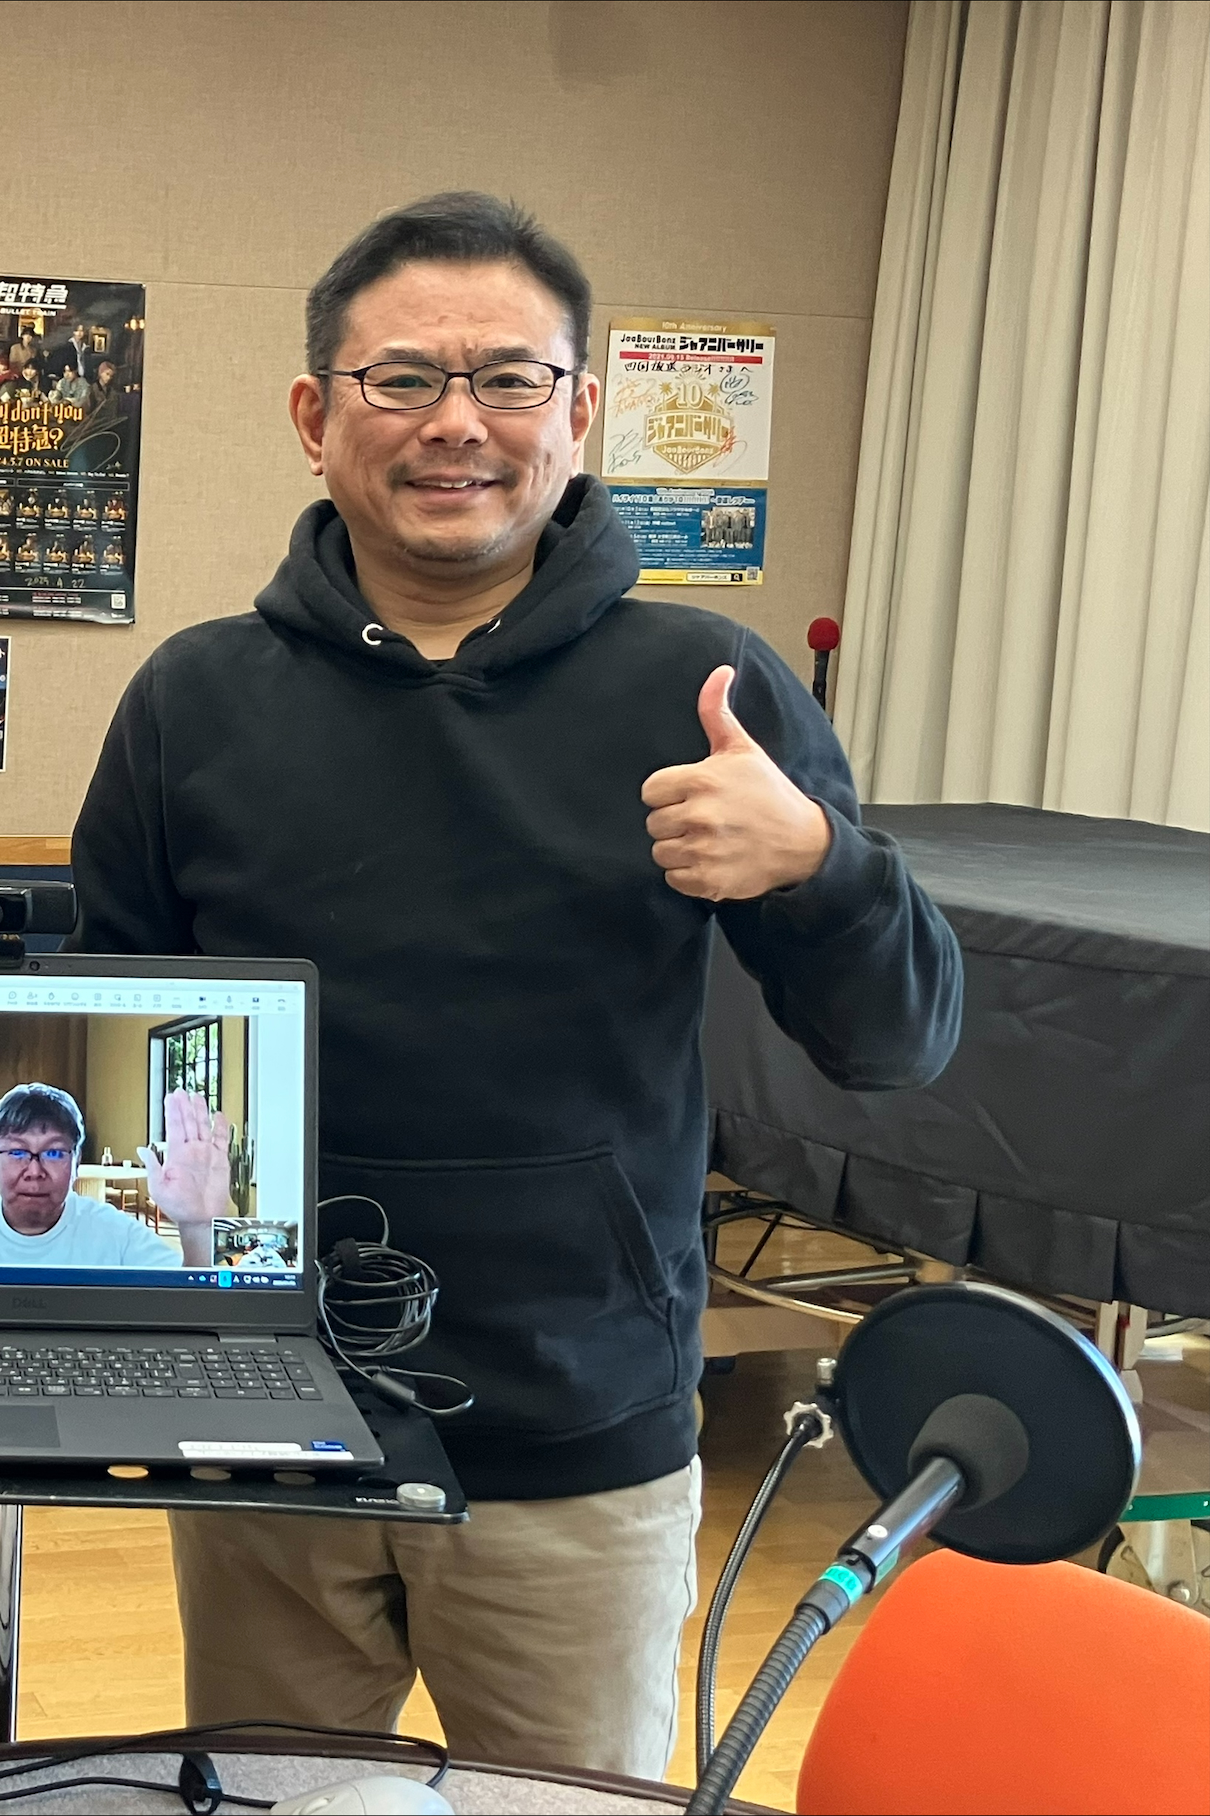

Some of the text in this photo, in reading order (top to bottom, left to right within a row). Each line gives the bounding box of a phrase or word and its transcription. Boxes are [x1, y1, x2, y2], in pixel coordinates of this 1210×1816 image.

[0, 307, 30, 315] BULLET
[662, 321, 727, 333] 10th Anniversary
[679, 336, 764, 353] ジャアニバーサリー
[677, 382, 704, 409] 10
[11, 399, 52, 425] don't
[54, 402, 83, 424] you
[25, 457, 41, 467] ON
[44, 457, 70, 468] SALE
